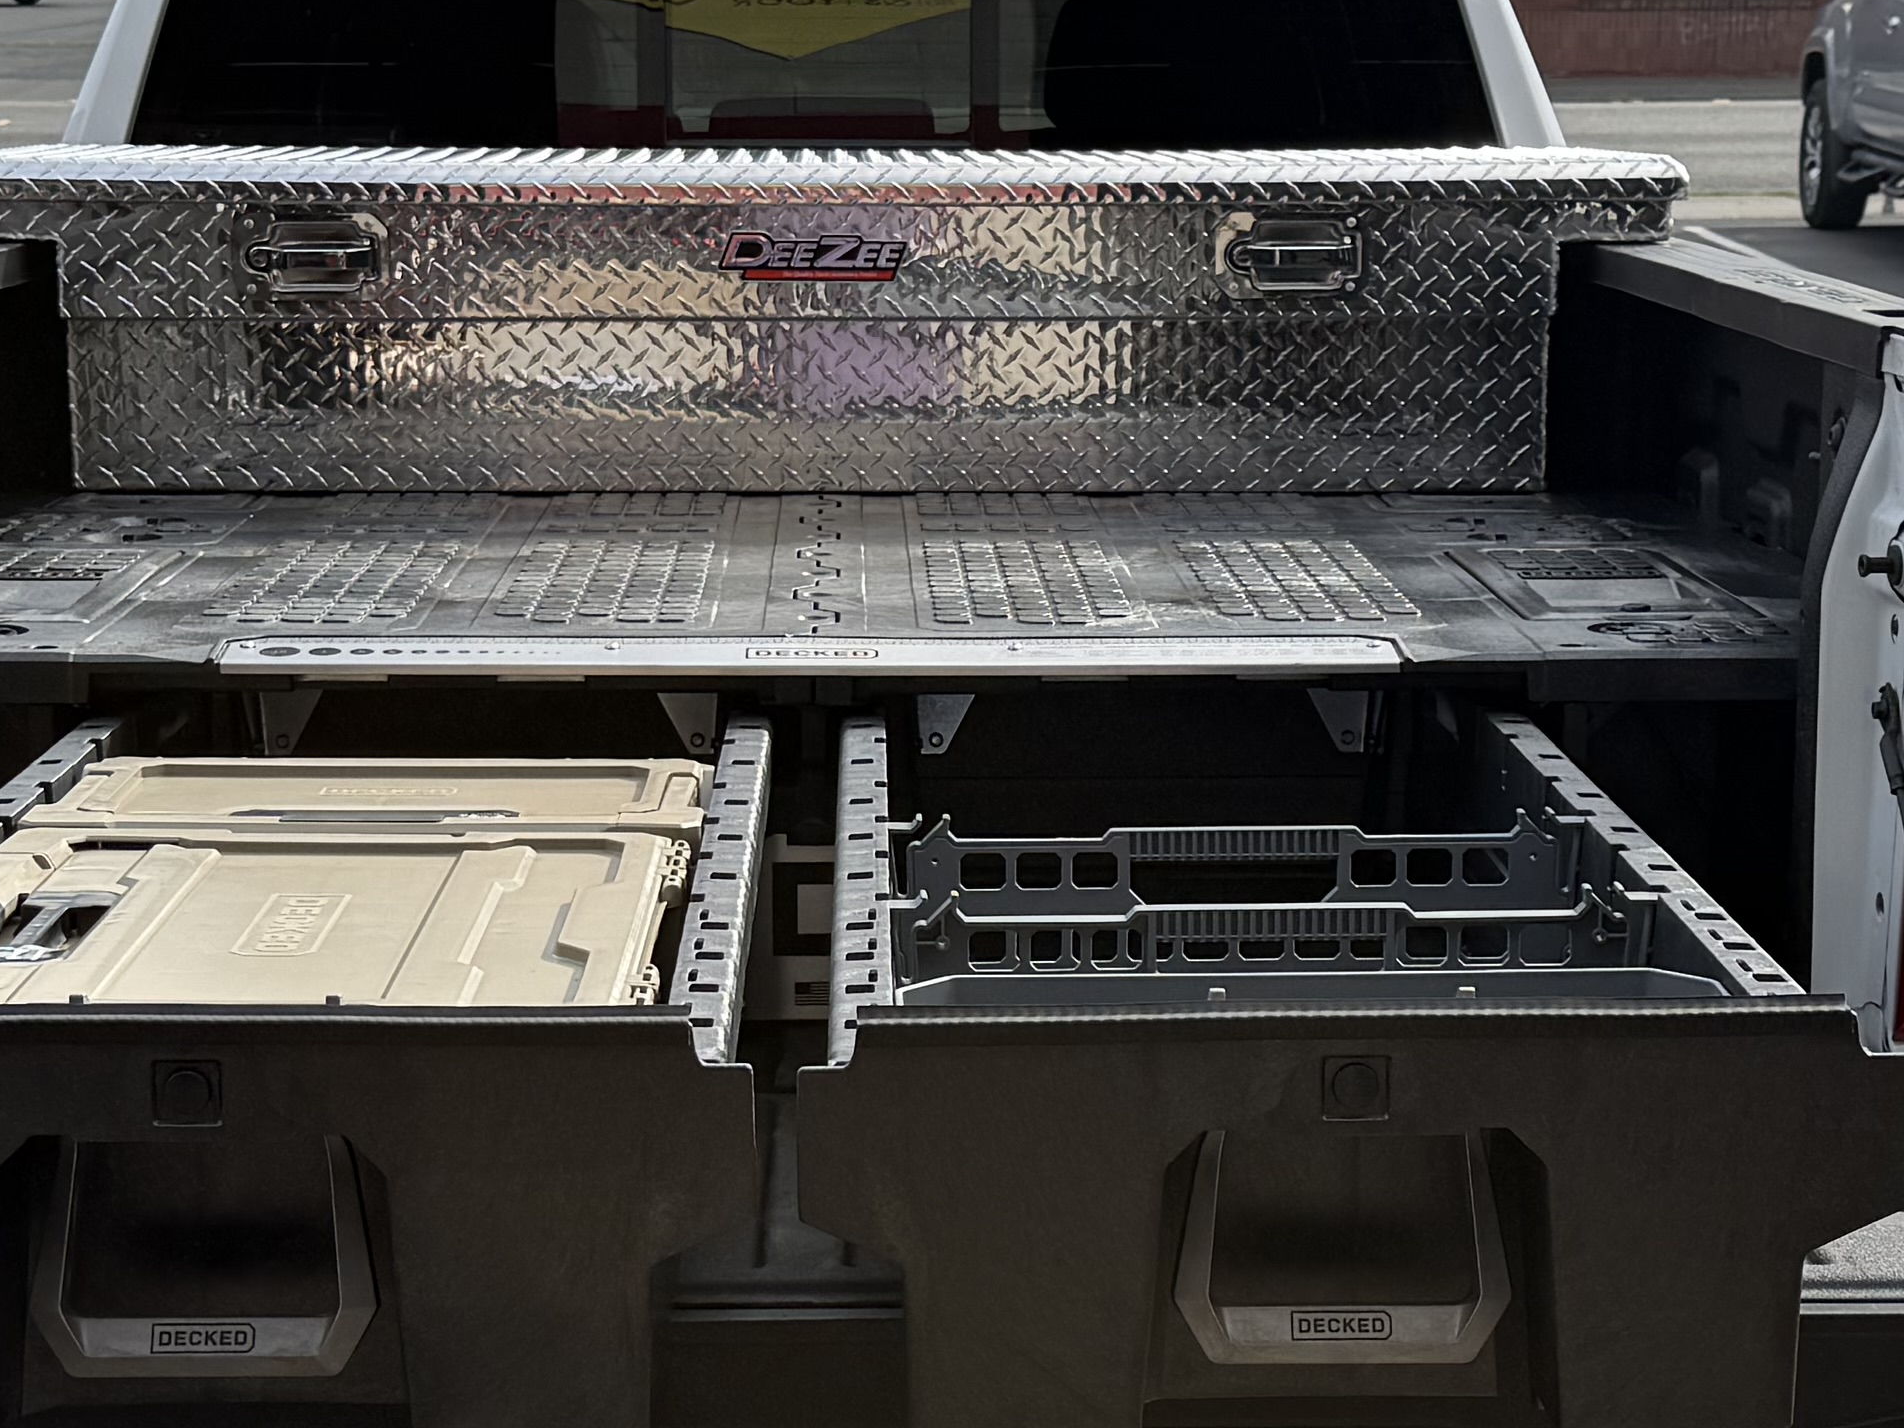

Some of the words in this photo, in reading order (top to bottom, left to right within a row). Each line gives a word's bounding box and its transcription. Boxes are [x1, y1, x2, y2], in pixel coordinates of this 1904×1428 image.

[755, 649, 869, 658] DECKED
[1298, 1317, 1386, 1334] DECKED
[158, 1330, 249, 1347] DECKED
